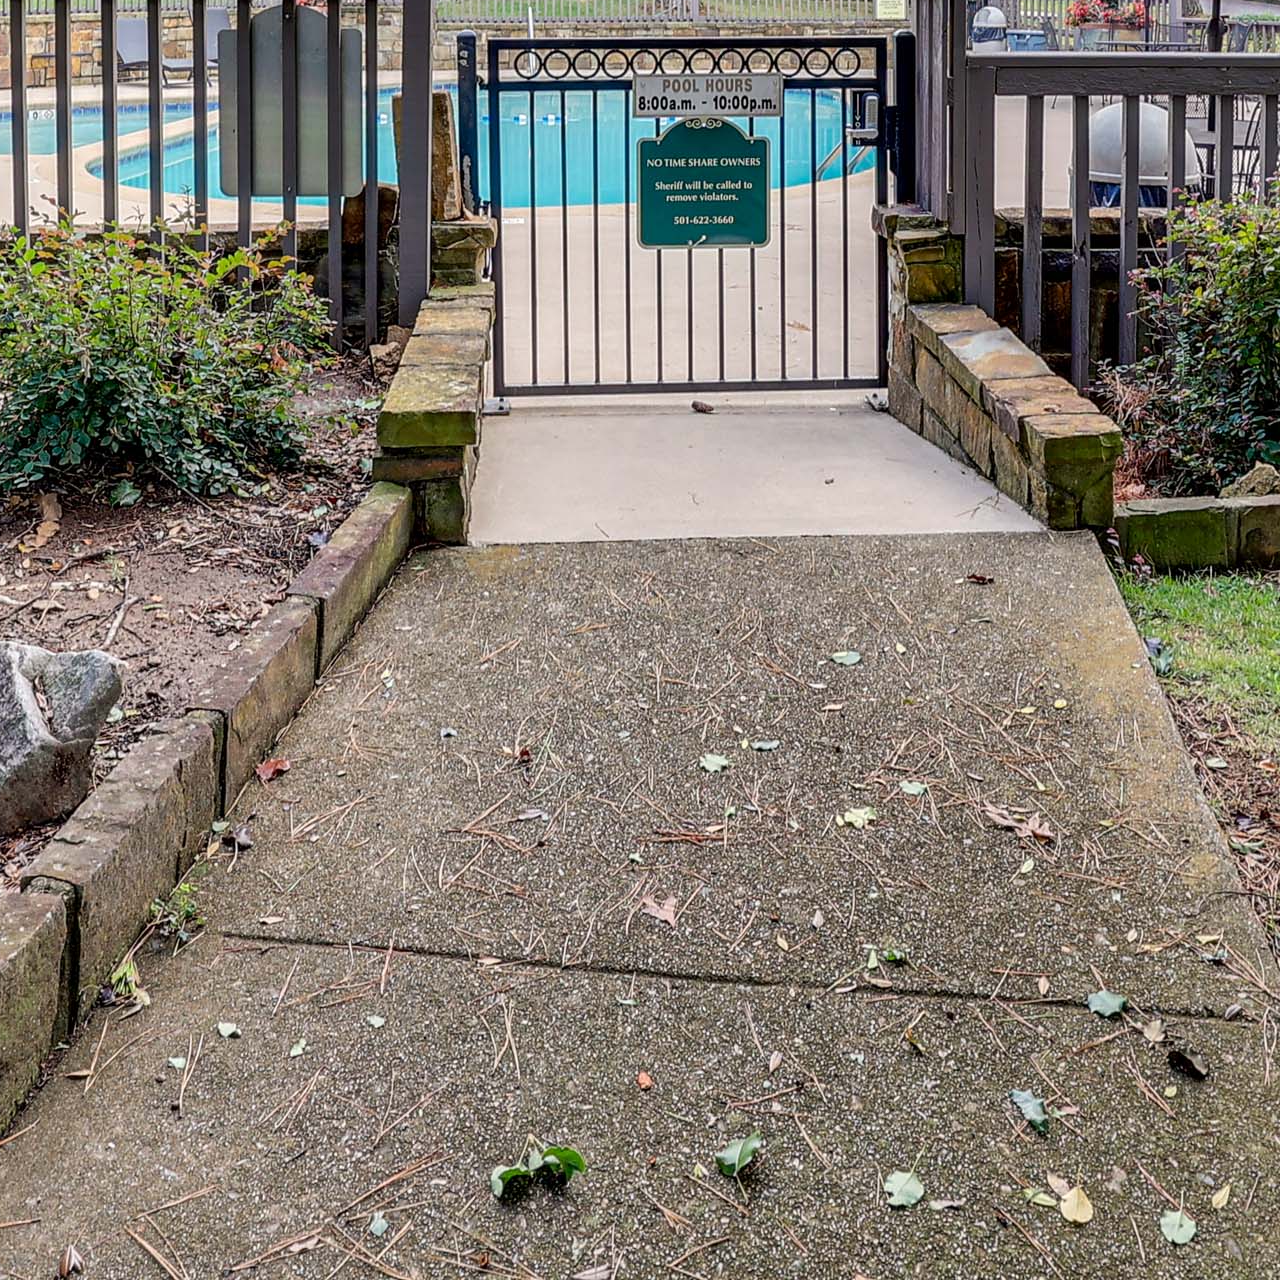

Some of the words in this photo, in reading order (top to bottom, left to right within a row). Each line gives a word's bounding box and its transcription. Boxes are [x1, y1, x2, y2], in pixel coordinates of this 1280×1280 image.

[662, 79, 700, 93] POOL
[705, 78, 753, 92] HOURS
[638, 96, 696, 111] 8:00a.m.
[712, 95, 777, 112] 10:00p.m.
[646, 158, 663, 168] NO
[663, 158, 687, 167] TIME
[688, 158, 718, 167] SHARE
[720, 157, 761, 167] OWNERS
[655, 181, 684, 190] Sheriff
[685, 180, 701, 190] will
[703, 180, 714, 190] be
[715, 180, 741, 190] called
[743, 181, 753, 189] to
[666, 194, 698, 202] remove
[699, 192, 739, 201] violators.
[673, 215, 734, 225] 501-622-3660
